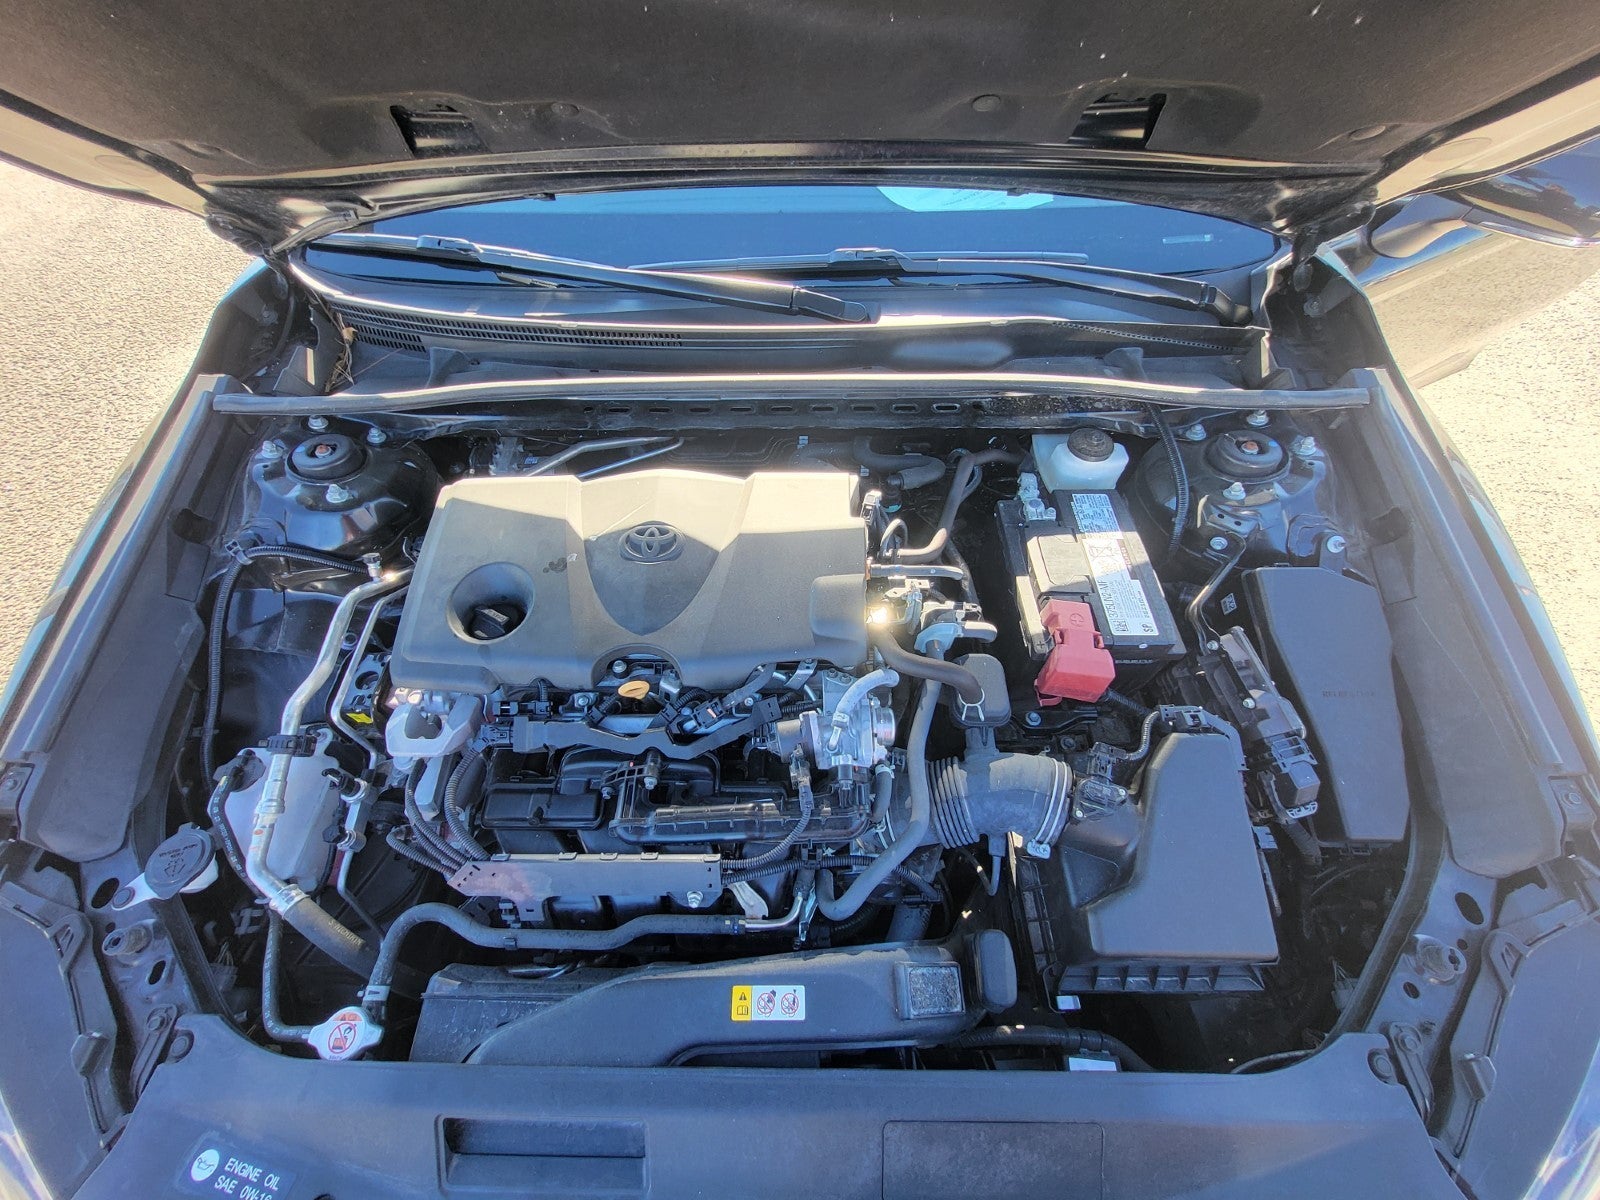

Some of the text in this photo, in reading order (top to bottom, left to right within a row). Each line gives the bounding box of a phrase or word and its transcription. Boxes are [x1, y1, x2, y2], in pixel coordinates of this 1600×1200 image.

[1142, 623, 1153, 633] SP
[224, 1158, 281, 1191] ENGINE OIL
[214, 1175, 239, 1194] SAE
